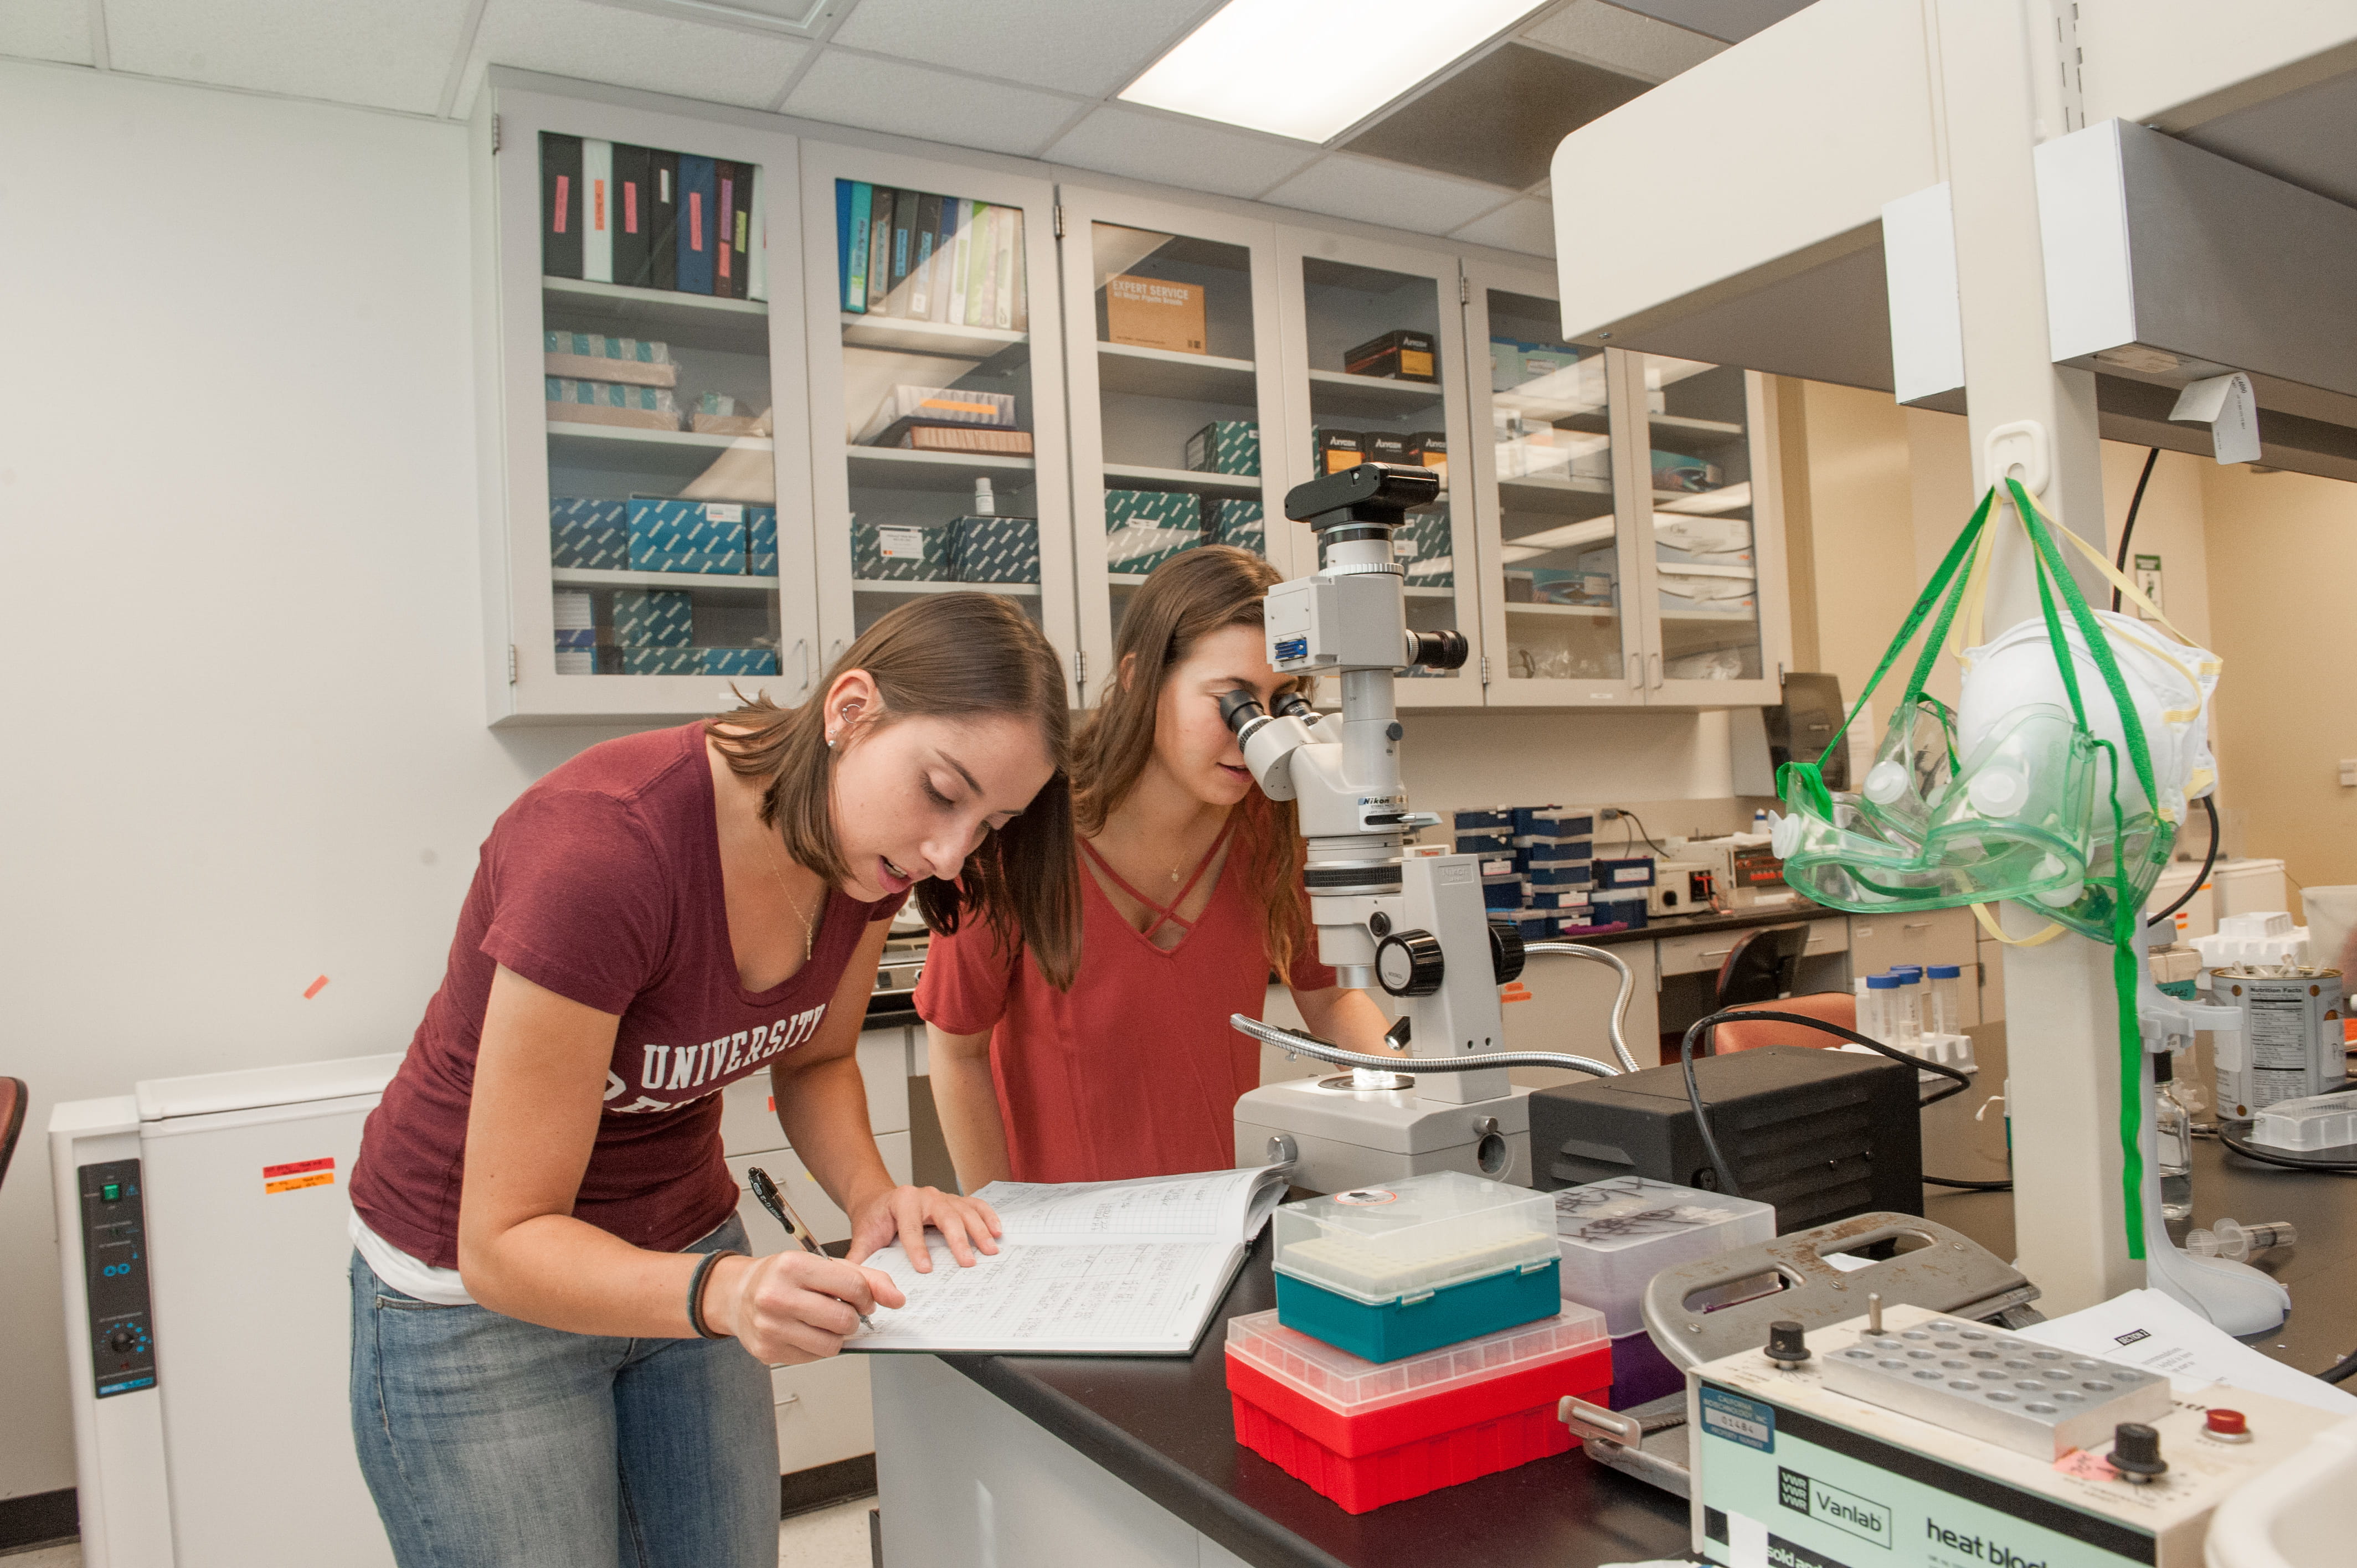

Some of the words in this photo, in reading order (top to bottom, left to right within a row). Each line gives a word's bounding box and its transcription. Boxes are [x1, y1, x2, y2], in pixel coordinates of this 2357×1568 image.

[1112, 281, 1147, 294] EXPERT
[1150, 285, 1189, 300] SERVICE
[641, 1004, 826, 1090] UNIVERSITY
[2118, 1331, 2142, 1344] SECTION
[1781, 1472, 1807, 1489] VWR
[1781, 1482, 1807, 1500] VWR
[1781, 1493, 1807, 1511] VWR
[1816, 1492, 1881, 1532] Vanlab
[1927, 1517, 1984, 1559] heat
